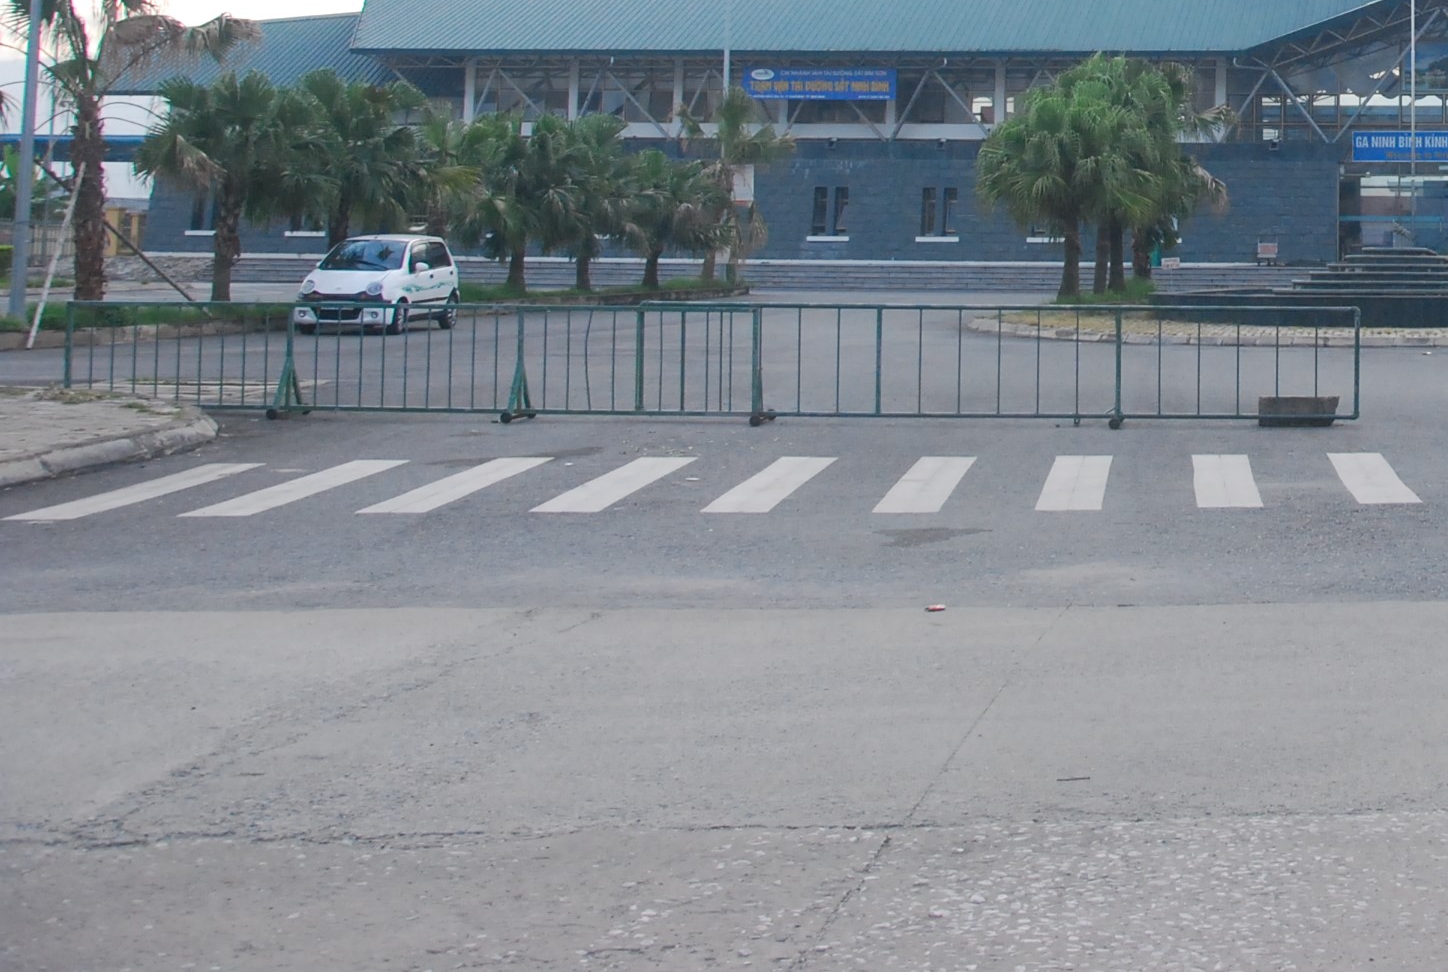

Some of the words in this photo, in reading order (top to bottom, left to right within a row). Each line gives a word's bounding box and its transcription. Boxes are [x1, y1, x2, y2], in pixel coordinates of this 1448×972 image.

[1355, 136, 1369, 148] GA
[1371, 136, 1396, 148] NINH
[1424, 133, 1448, 148] KÍNH
